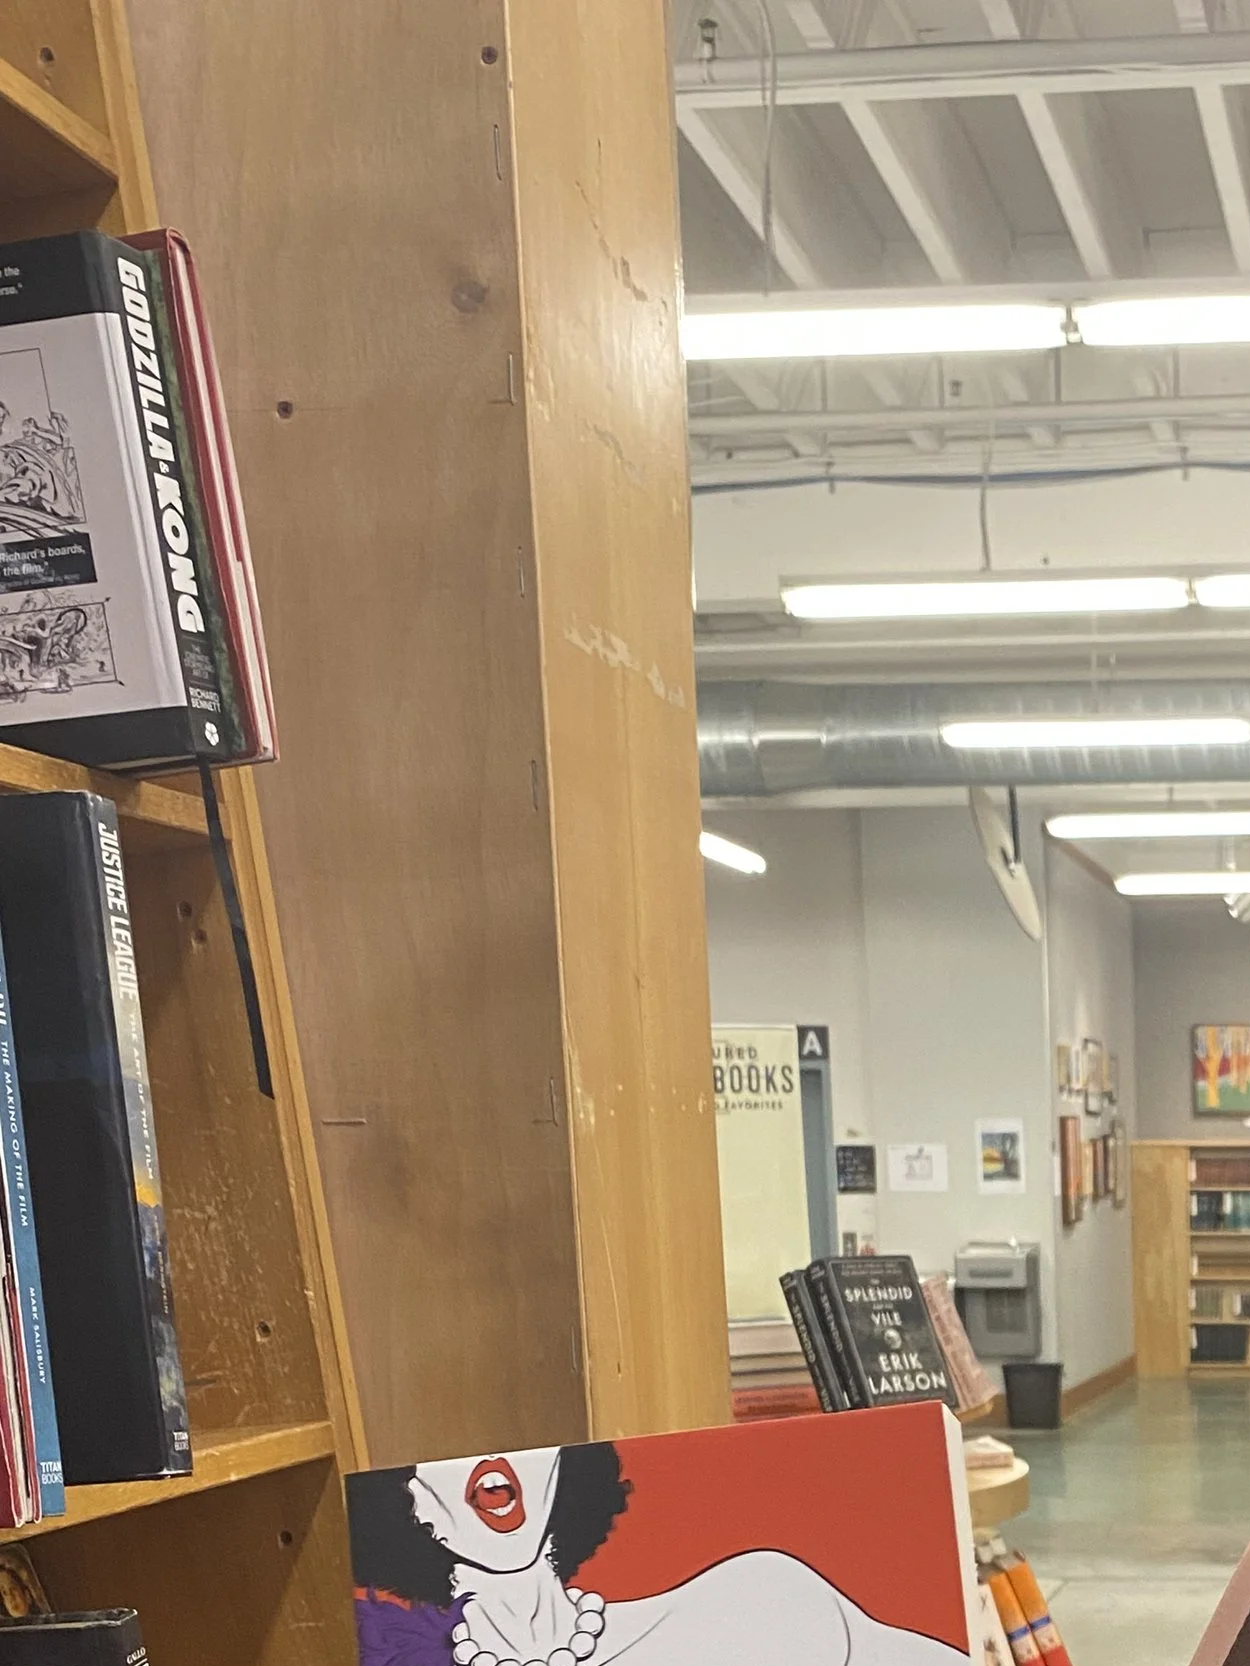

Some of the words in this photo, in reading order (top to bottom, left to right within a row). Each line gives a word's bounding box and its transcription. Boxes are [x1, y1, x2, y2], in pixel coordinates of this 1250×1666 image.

[117, 256, 175, 462] GODZILLA
[159, 461, 170, 474] &
[47, 544, 86, 558] boards,
[153, 472, 206, 633] KONG
[98, 821, 128, 914] JUSTICE
[110, 914, 138, 1001] LEAGUE
[1, 1041, 11, 1067] THE
[802, 1029, 824, 1057] A
[133, 1047, 143, 1081] ART
[713, 1064, 795, 1095] BOOKS
[4, 1071, 19, 1134] MAKING
[138, 1083, 146, 1105] OF
[140, 1108, 150, 1139] THE
[12, 1139, 21, 1160] OF
[144, 1144, 155, 1180] FILM
[15, 1165, 25, 1190] THE
[19, 1195, 29, 1227] FILM
[29, 1286, 39, 1320] MARK
[844, 1285, 914, 1303] SPLENDID
[870, 1311, 902, 1327] VILE
[33, 1324, 46, 1384] SALISBURY
[878, 1351, 923, 1373] ERIK
[868, 1371, 948, 1395] LARSON
[40, 1461, 63, 1474] TITAN
[41, 1472, 64, 1486] BOOKS
